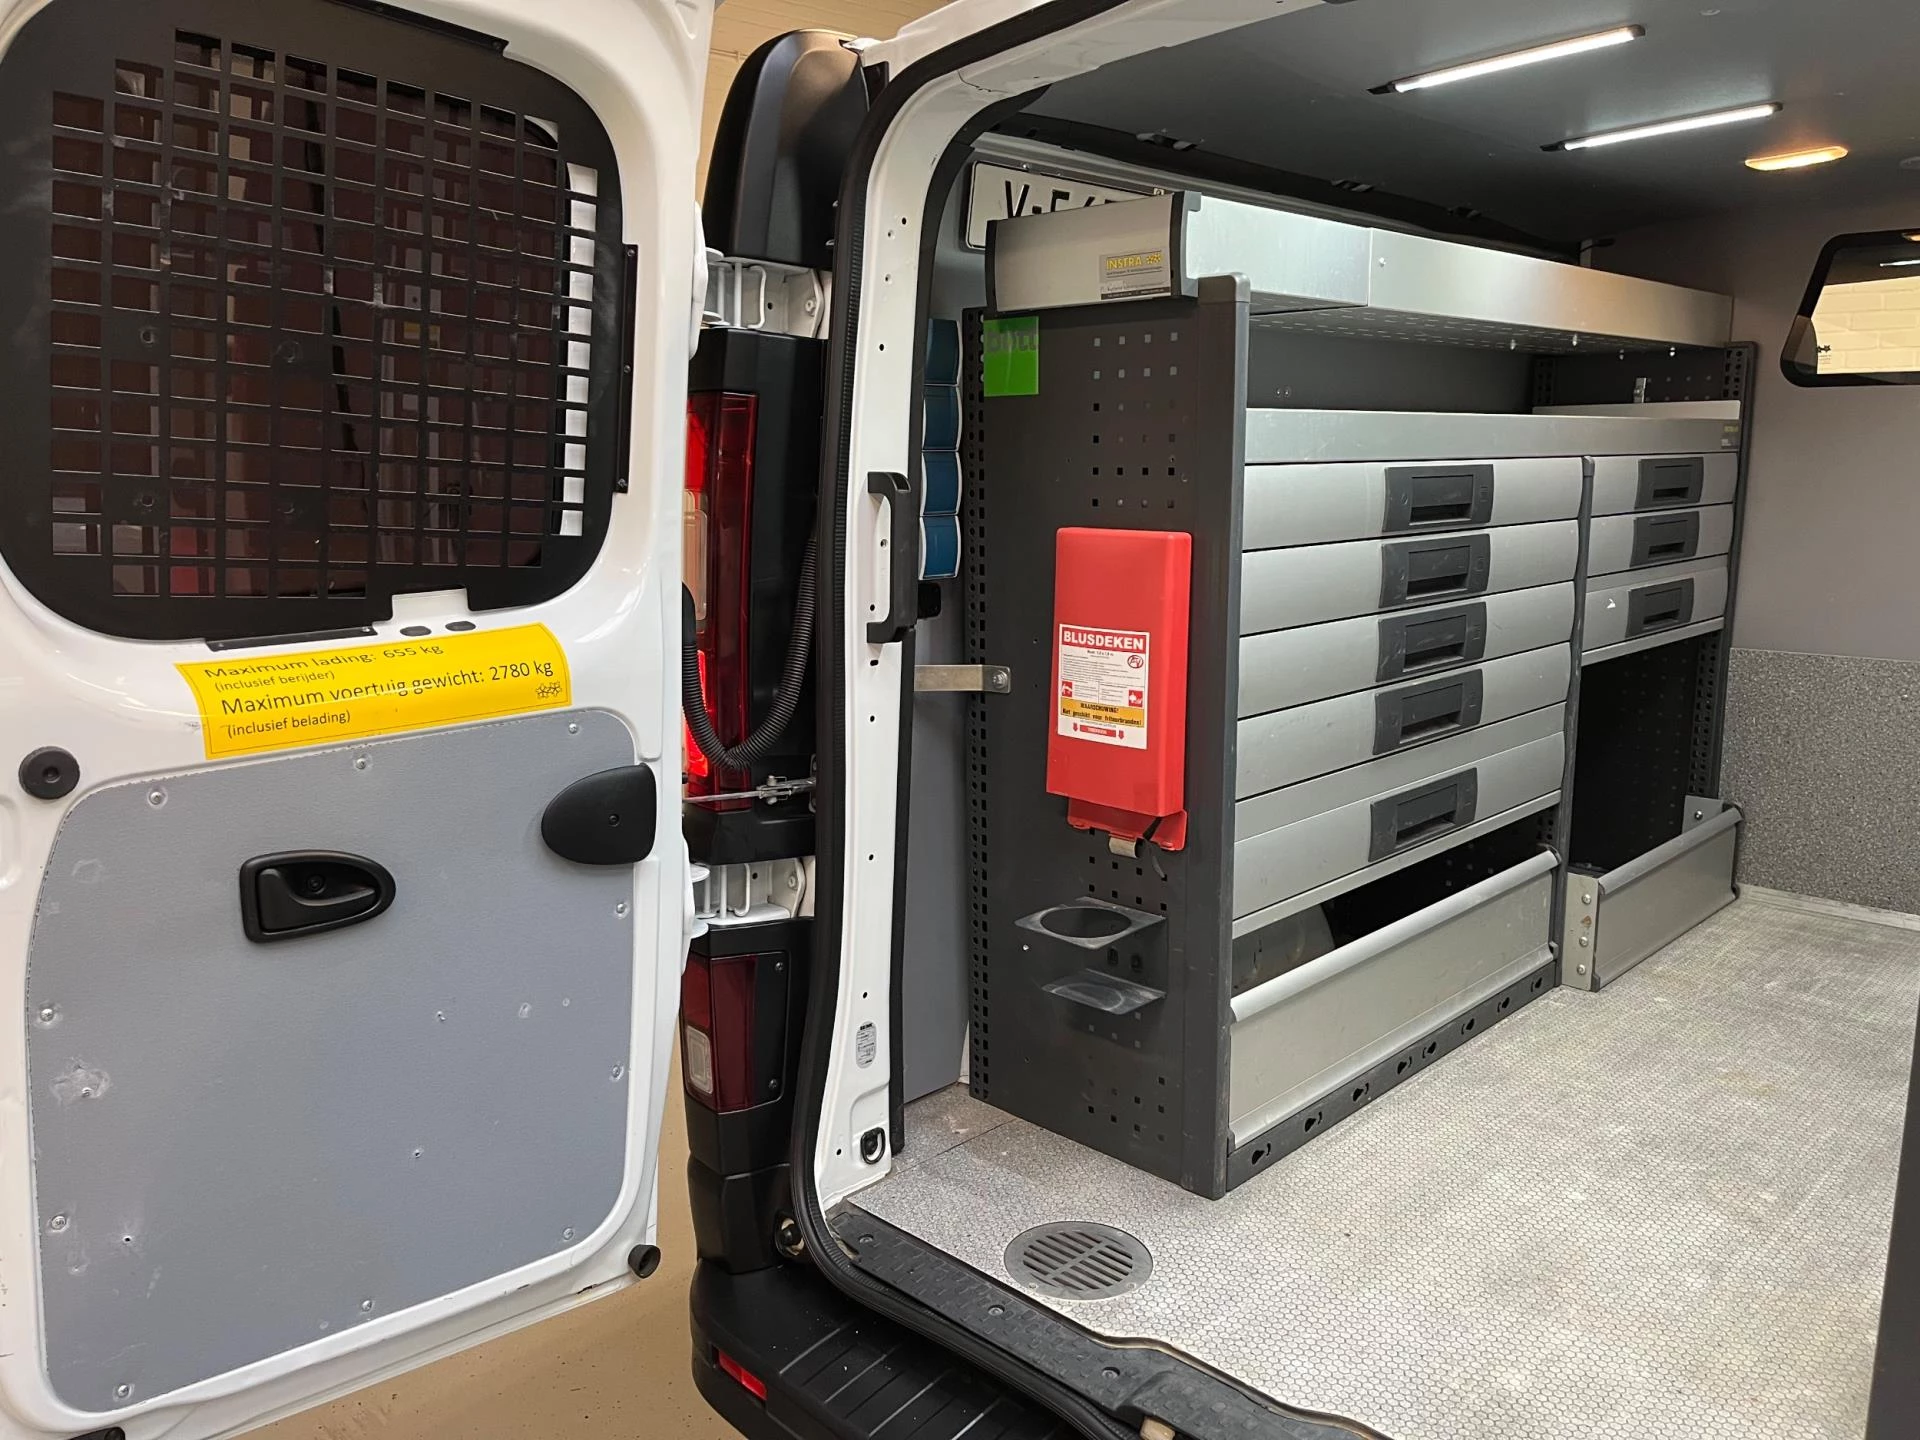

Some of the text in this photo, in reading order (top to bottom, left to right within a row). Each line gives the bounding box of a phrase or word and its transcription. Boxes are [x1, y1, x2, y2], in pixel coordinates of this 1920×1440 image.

[1106, 255, 1142, 271] INSTRA
[1063, 631, 1144, 650] BLUSDEKEN
[204, 645, 444, 678] Maximum lading: 655 kg
[214, 670, 335, 693] (inclusief berijder)
[221, 660, 554, 715] Maximum voertuig gewicht: 2780 kg
[227, 709, 351, 739] (inclusief belading)
